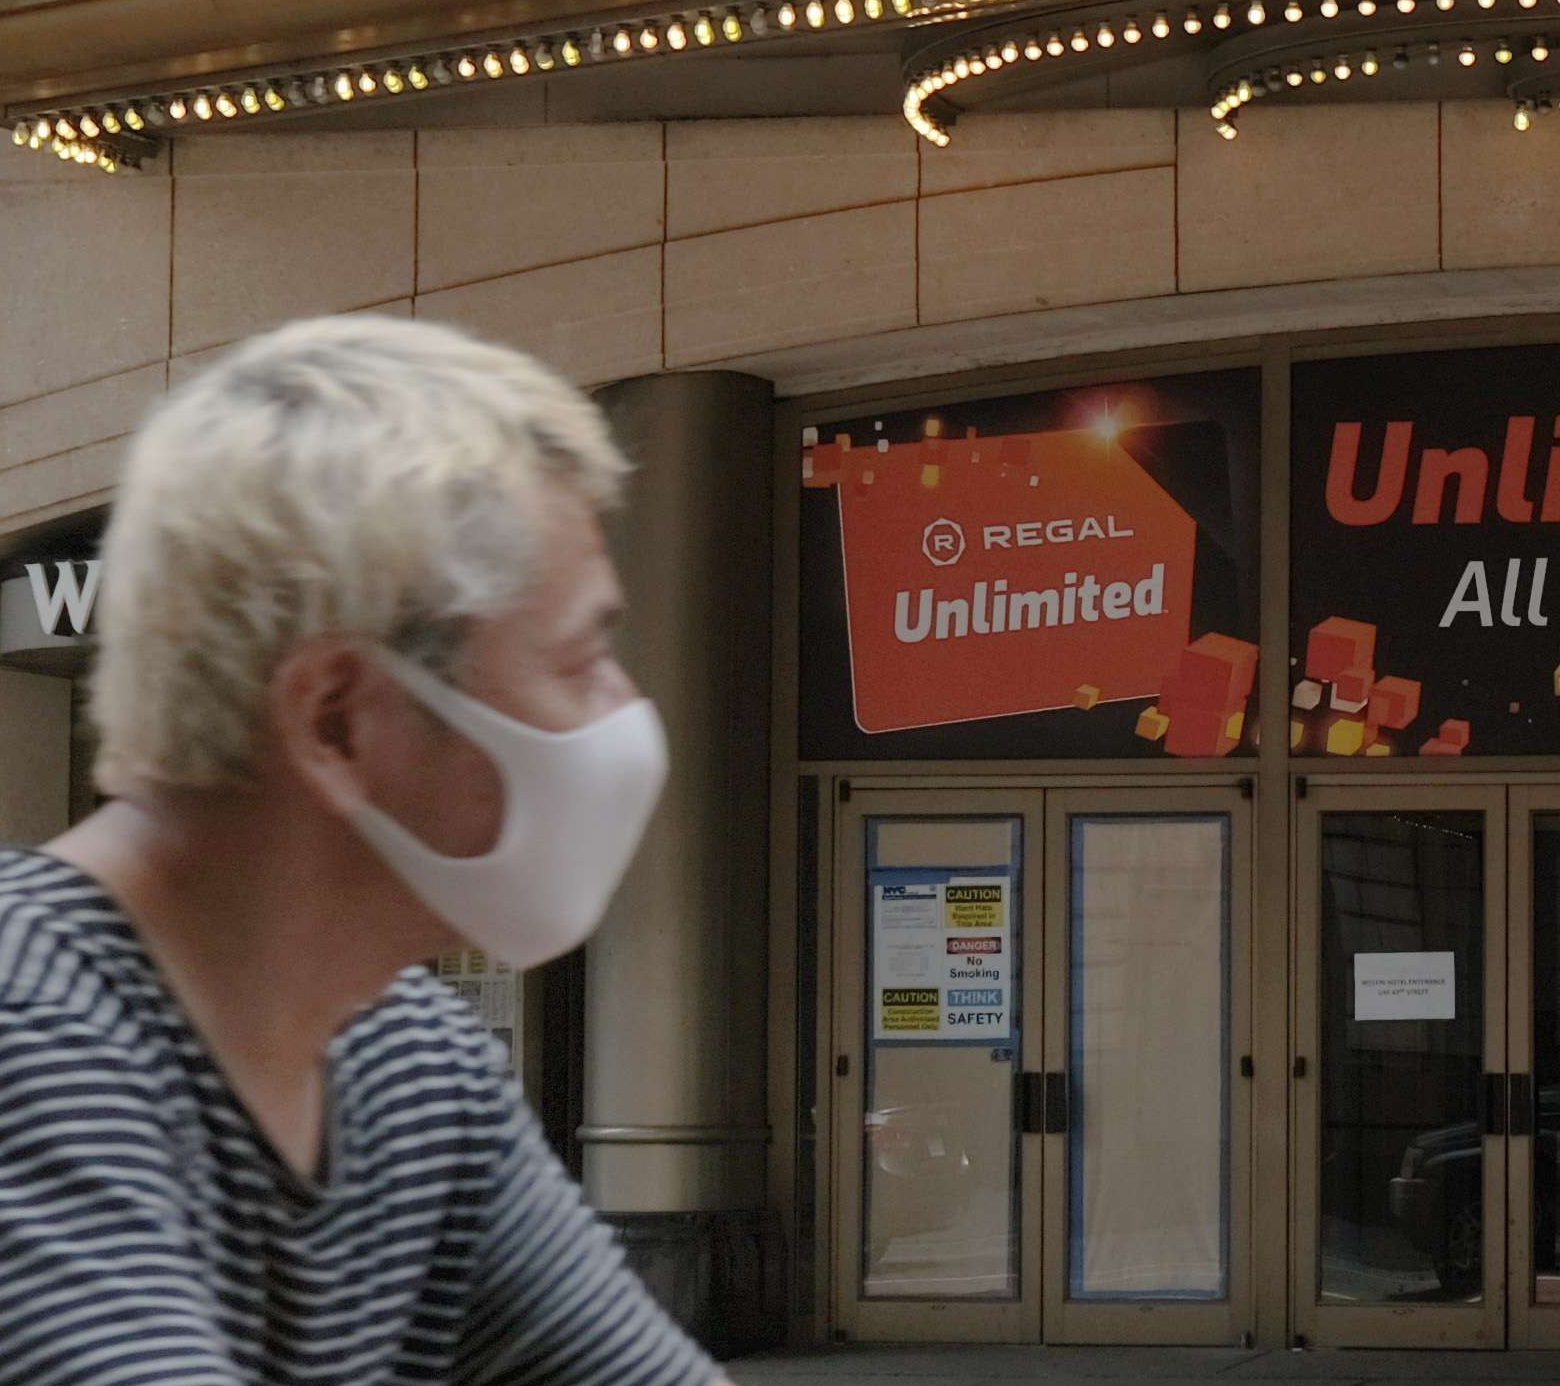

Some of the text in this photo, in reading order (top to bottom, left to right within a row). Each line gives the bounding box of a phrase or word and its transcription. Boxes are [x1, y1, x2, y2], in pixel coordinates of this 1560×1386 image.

[983, 515, 1134, 550] REGAL
[1439, 557, 1548, 627] All
[894, 563, 1166, 643] Unlimited
[883, 886, 906, 894] NYC
[947, 888, 1001, 901] CAUTION
[951, 941, 997, 951] DANGER
[967, 957, 982, 966] No
[950, 968, 1000, 980] Smoking
[883, 992, 938, 1003] CAUTION
[953, 992, 998, 1004] THINK
[948, 1013, 1003, 1025] SAFETY
